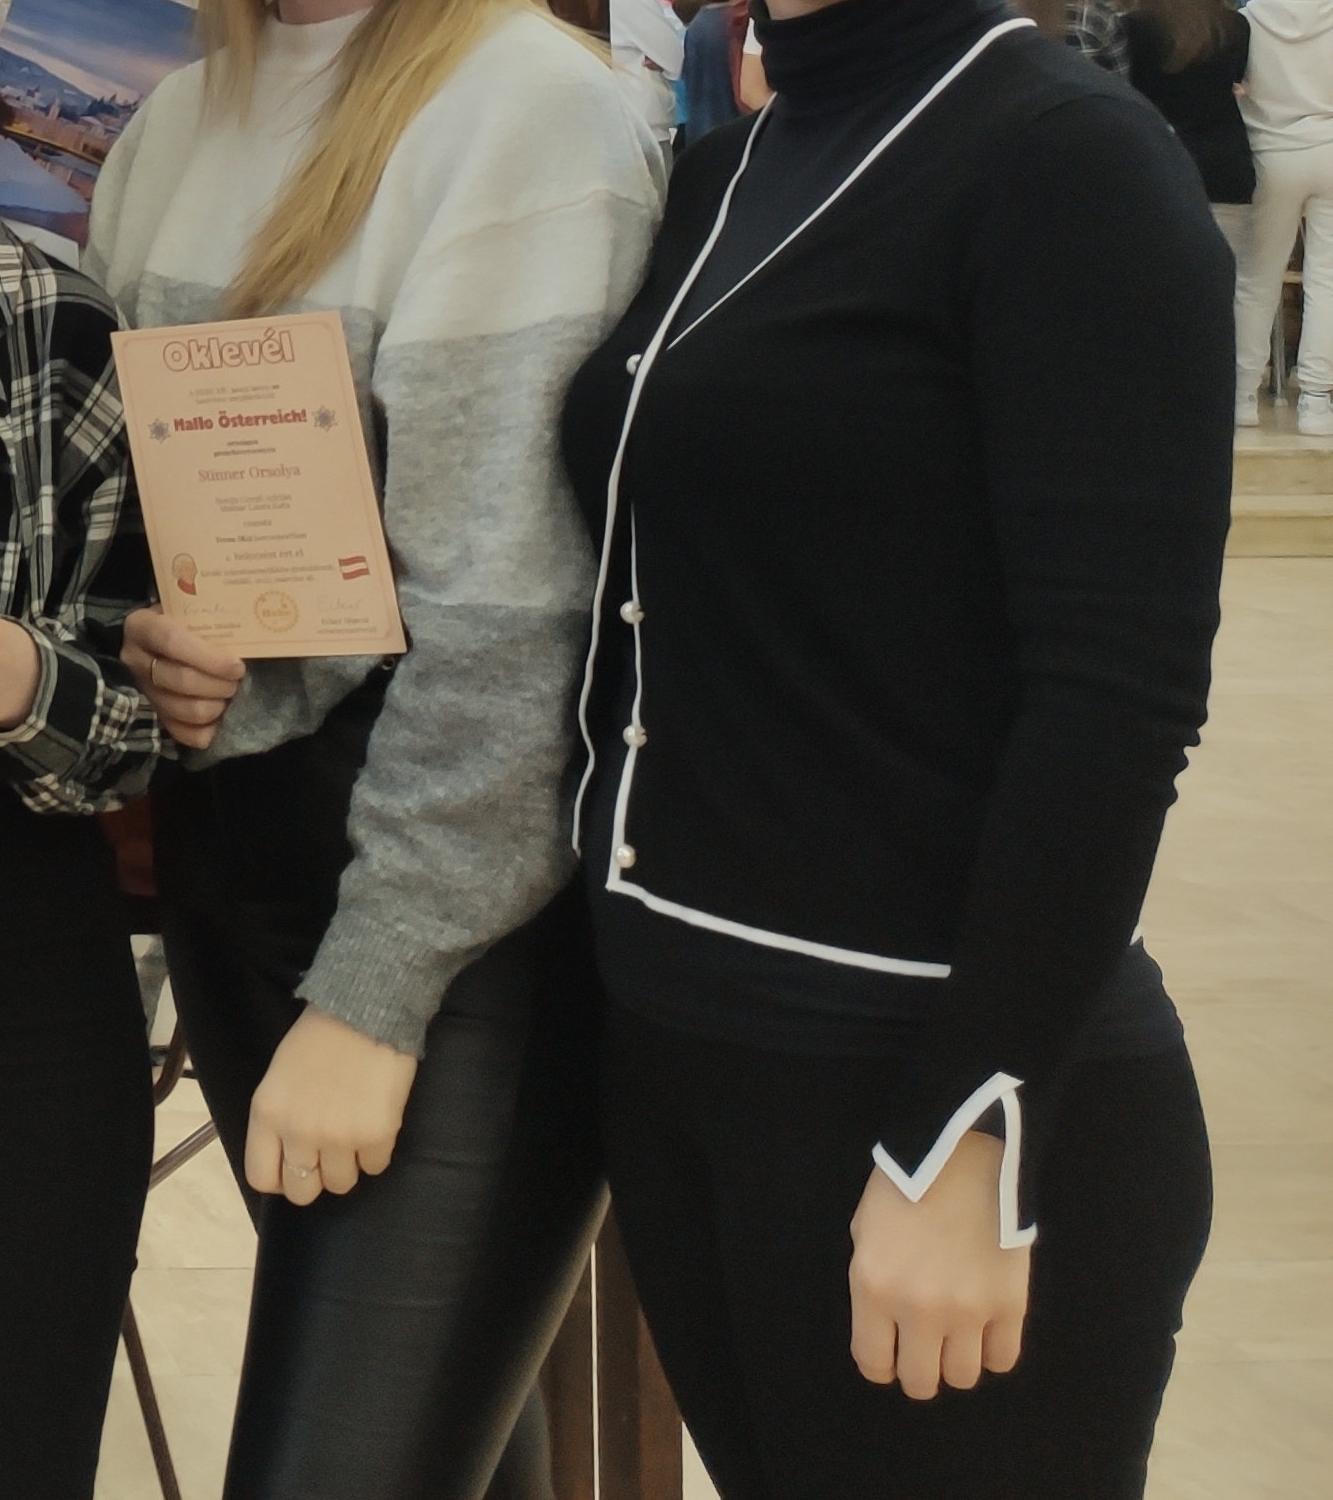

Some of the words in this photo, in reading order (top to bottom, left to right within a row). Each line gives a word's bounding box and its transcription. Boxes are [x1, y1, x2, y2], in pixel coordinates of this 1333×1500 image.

[162, 327, 295, 372] Oklevél
[174, 417, 213, 431] Hallo
[218, 408, 307, 428] Österreich!
[249, 464, 301, 479] Orsolya
